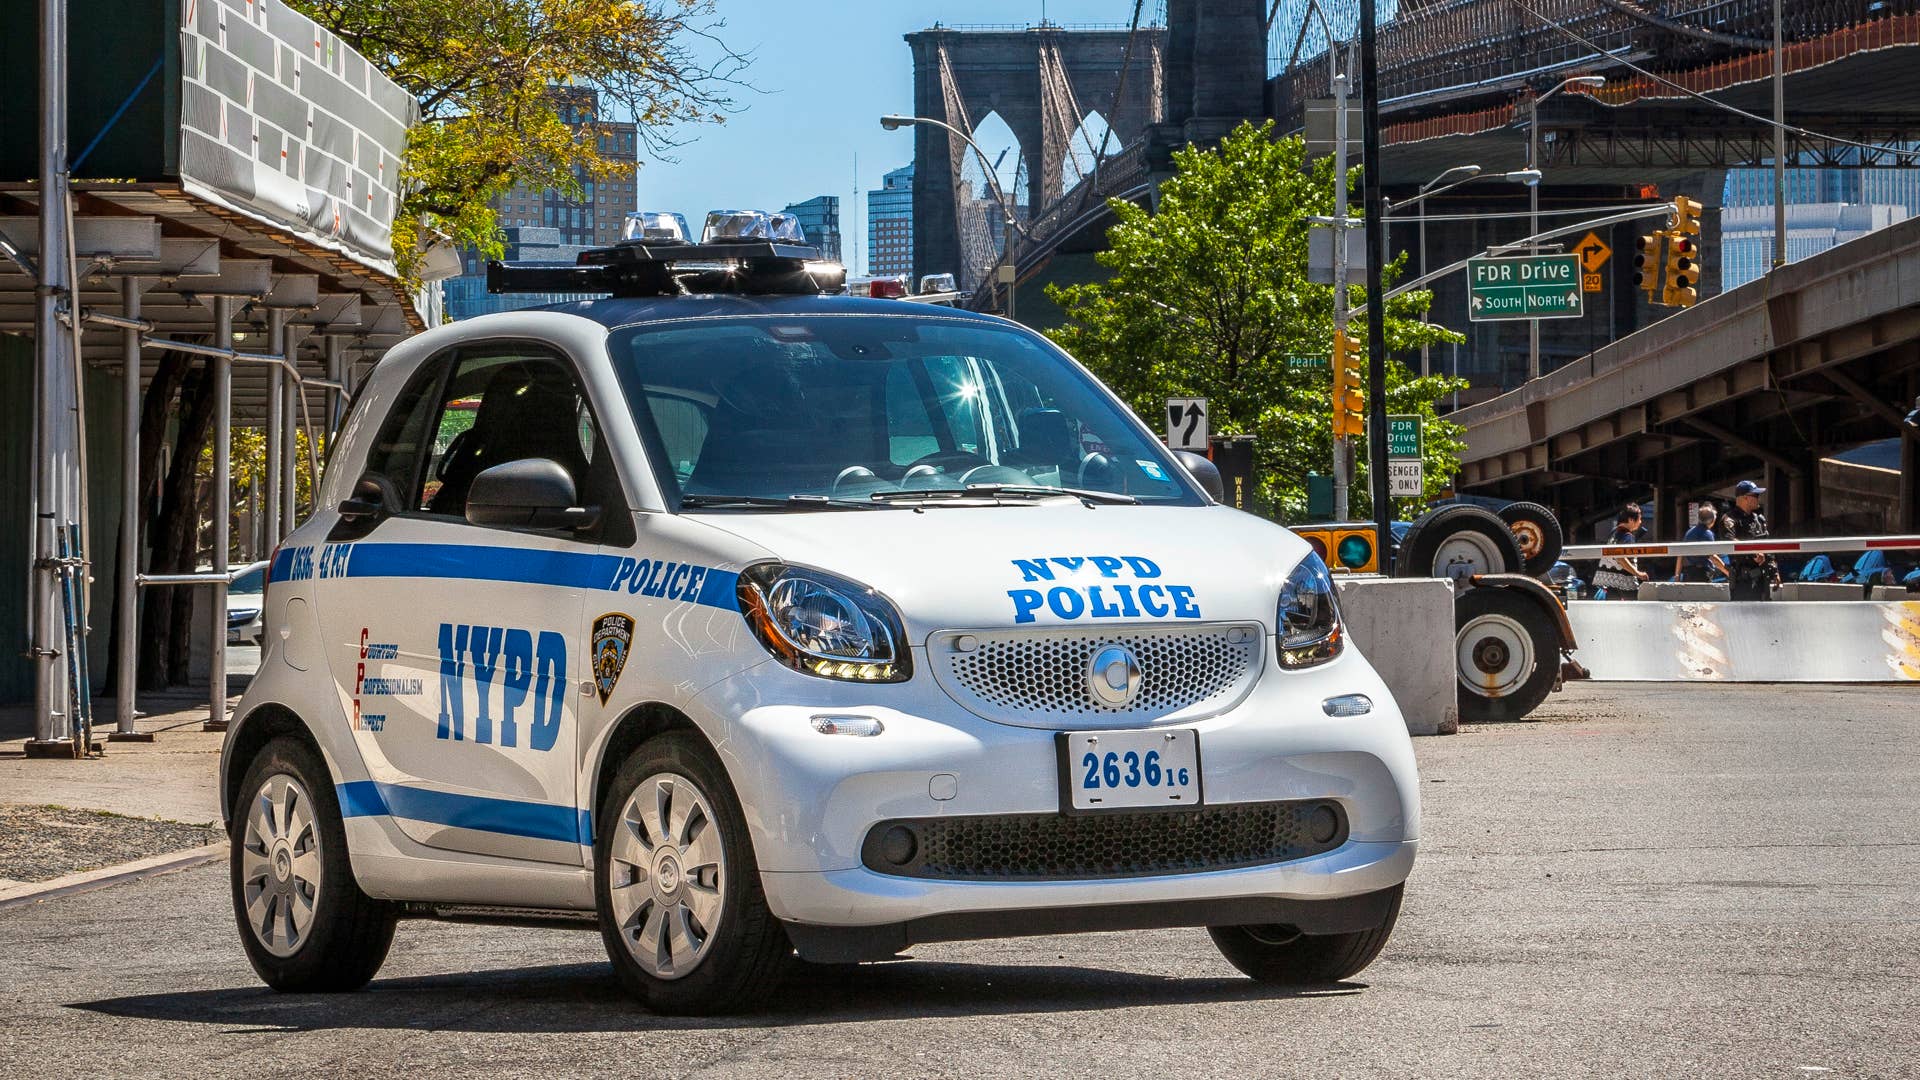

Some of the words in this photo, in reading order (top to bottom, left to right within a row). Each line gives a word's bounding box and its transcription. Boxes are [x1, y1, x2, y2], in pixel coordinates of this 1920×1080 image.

[1477, 264, 1511, 281] FDR
[1521, 261, 1570, 279] Drive
[1585, 275, 1600, 285] 20
[1485, 296, 1522, 309] SOUTH
[1528, 294, 1566, 307] NORTH
[1290, 355, 1317, 368] Pearl
[1391, 421, 1413, 431] FDR
[1387, 433, 1416, 442] Drive
[1387, 445, 1417, 454] SOUTH
[1388, 466, 1419, 476] SENGER
[1398, 480, 1419, 490] ONLY
[1011, 556, 1162, 582] NYPD
[610, 557, 707, 603] POLICE
[1006, 584, 1202, 624] POLICE
[602, 616, 626, 628] POLICE
[594, 626, 631, 644] DEPARTMENT
[437, 623, 567, 752] NYPD
[1081, 750, 1162, 789] 2636
[1165, 767, 1190, 787] 16
